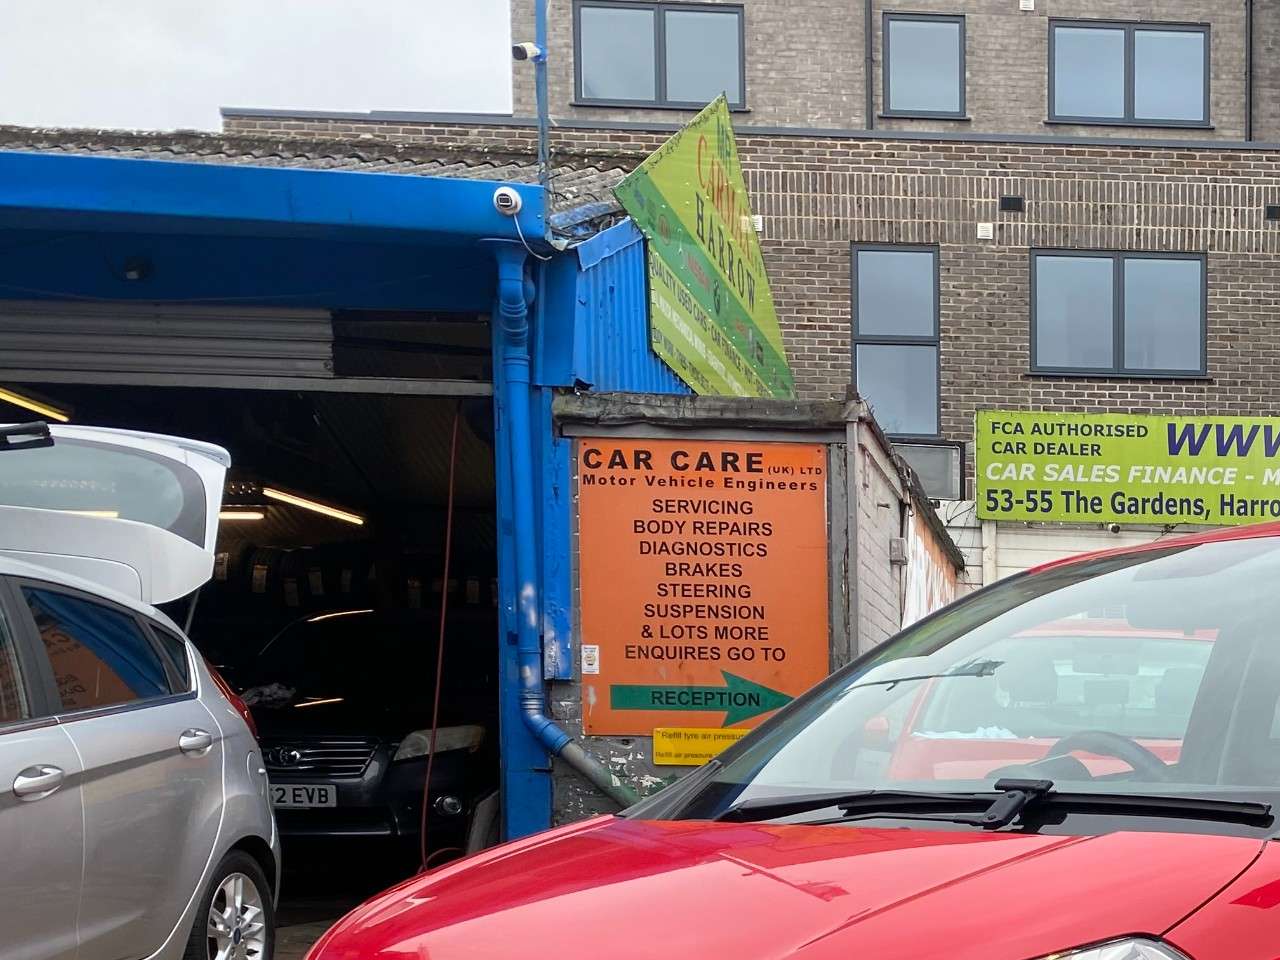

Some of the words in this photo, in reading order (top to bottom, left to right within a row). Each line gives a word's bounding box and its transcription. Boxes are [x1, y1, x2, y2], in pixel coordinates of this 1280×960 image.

[695, 191, 755, 314] HARROW
[991, 422, 1024, 435] FCA
[1031, 424, 1148, 438] AUTHORISED
[991, 441, 1027, 455] CAR
[1033, 443, 1102, 456] DEALER
[583, 448, 653, 470] CAR
[670, 450, 763, 473] CARE
[767, 466, 794, 476] (UK)
[800, 467, 822, 475] LTD
[985, 463, 1036, 481] CAR
[1042, 464, 1121, 482] SALES
[1127, 465, 1238, 485] FINANCE
[583, 474, 636, 486] Motor
[645, 475, 715, 488] Vehicle
[723, 477, 818, 492] Engineers
[652, 499, 754, 515] SERVICING
[986, 489, 1053, 513] 53-55
[1061, 490, 1103, 514] The
[1111, 491, 1211, 521] Gardens,
[633, 520, 686, 534] BODY
[692, 521, 773, 536] REPAIRS
[639, 541, 768, 557] DIAGNOSTICS
[665, 562, 743, 577] BRAKES
[657, 583, 751, 598] STEERING
[644, 604, 765, 620] SUSPENSION
[641, 625, 653, 639] &
[660, 625, 708, 639] LOTS
[714, 626, 769, 640] MORE
[624, 645, 721, 661] ENQUIRES
[727, 647, 755, 661] GO
[761, 647, 786, 661] TO
[651, 691, 760, 707] RECEPTION
[292, 787, 329, 804] EVB
